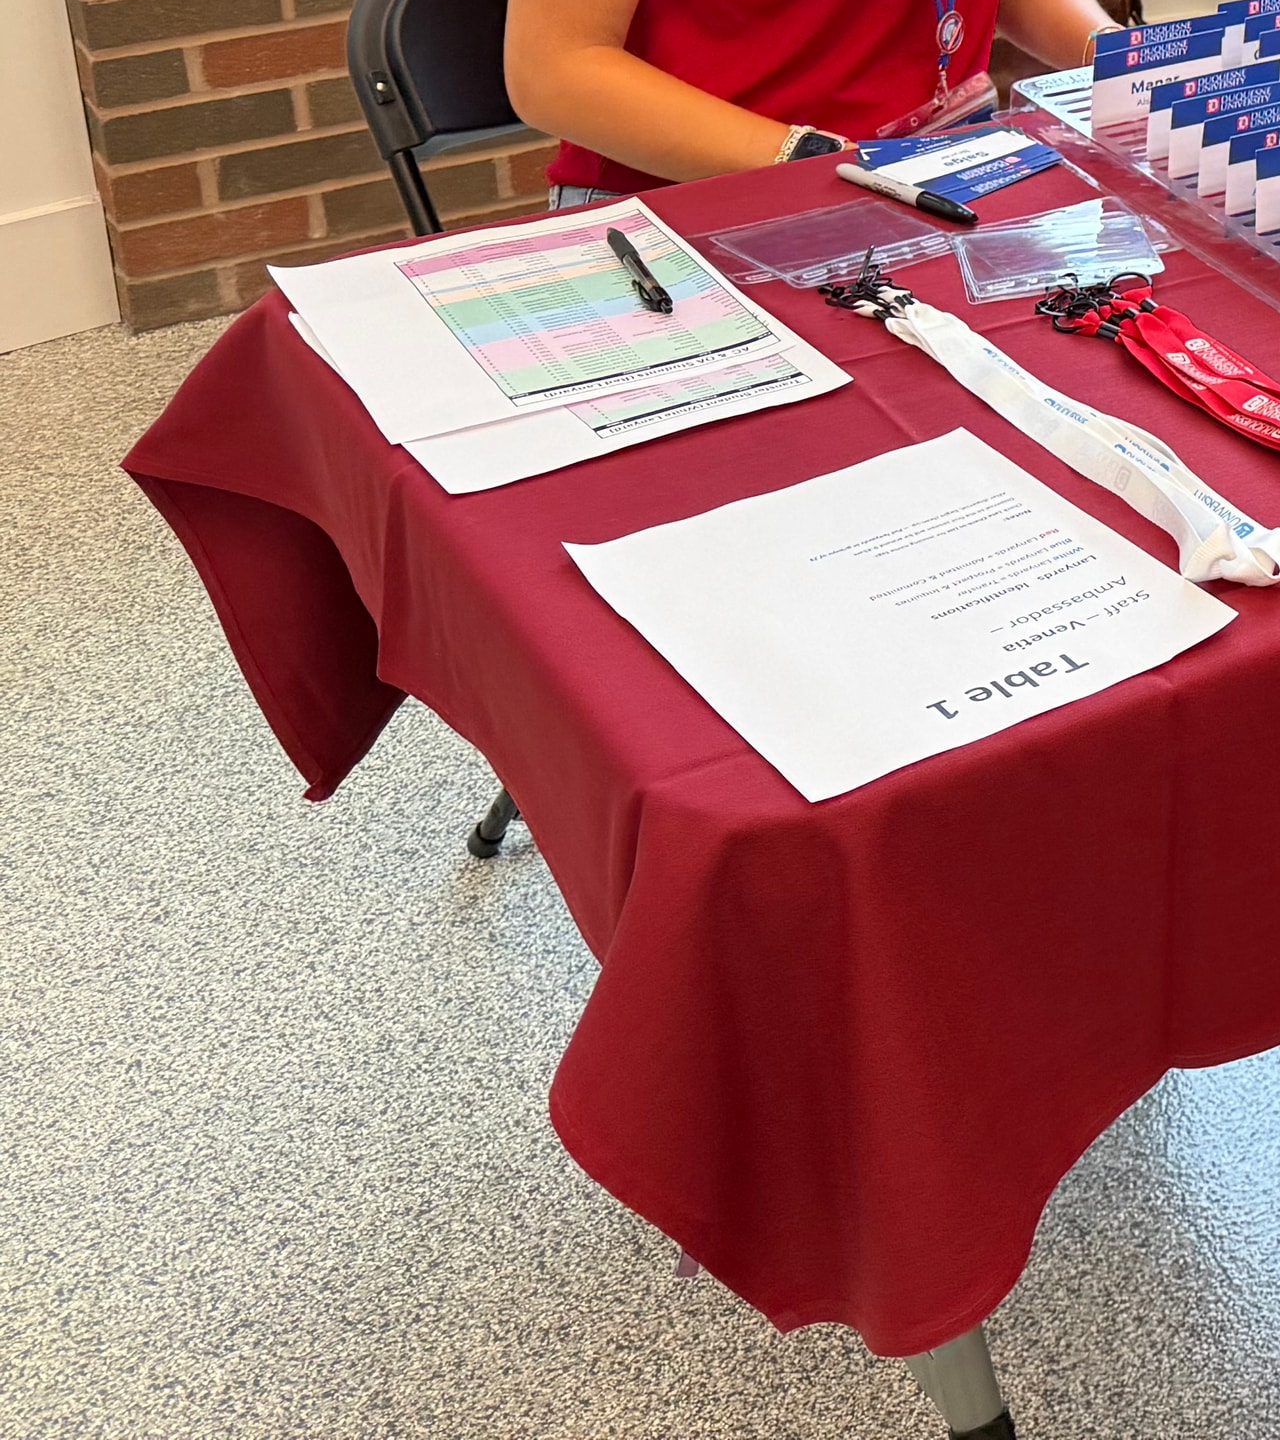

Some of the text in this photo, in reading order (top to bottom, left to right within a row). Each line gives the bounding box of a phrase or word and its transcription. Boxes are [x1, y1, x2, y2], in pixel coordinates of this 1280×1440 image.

[1141, 40, 1187, 56] DUQUESNE
[1198, 70, 1245, 86] DUQUESNE
[1221, 87, 1270, 103] DUQUESNE
[1039, 528, 1060, 539] Red
[1048, 537, 1073, 550] Blue
[994, 536, 1039, 557] Lanyards
[1004, 546, 1050, 567] Lanyards
[1053, 546, 1085, 563] White
[938, 557, 986, 577] Admitted
[1008, 557, 1053, 580] Lanyards
[868, 579, 926, 602] Committed
[931, 554, 1096, 621] Lanyards Identifications
[956, 579, 999, 598] Transfer
[1009, 576, 1128, 628] Ambassador
[1103, 590, 1150, 618] Staff
[1003, 620, 1086, 654] Venetia
[926, 654, 1090, 721] Table 1
